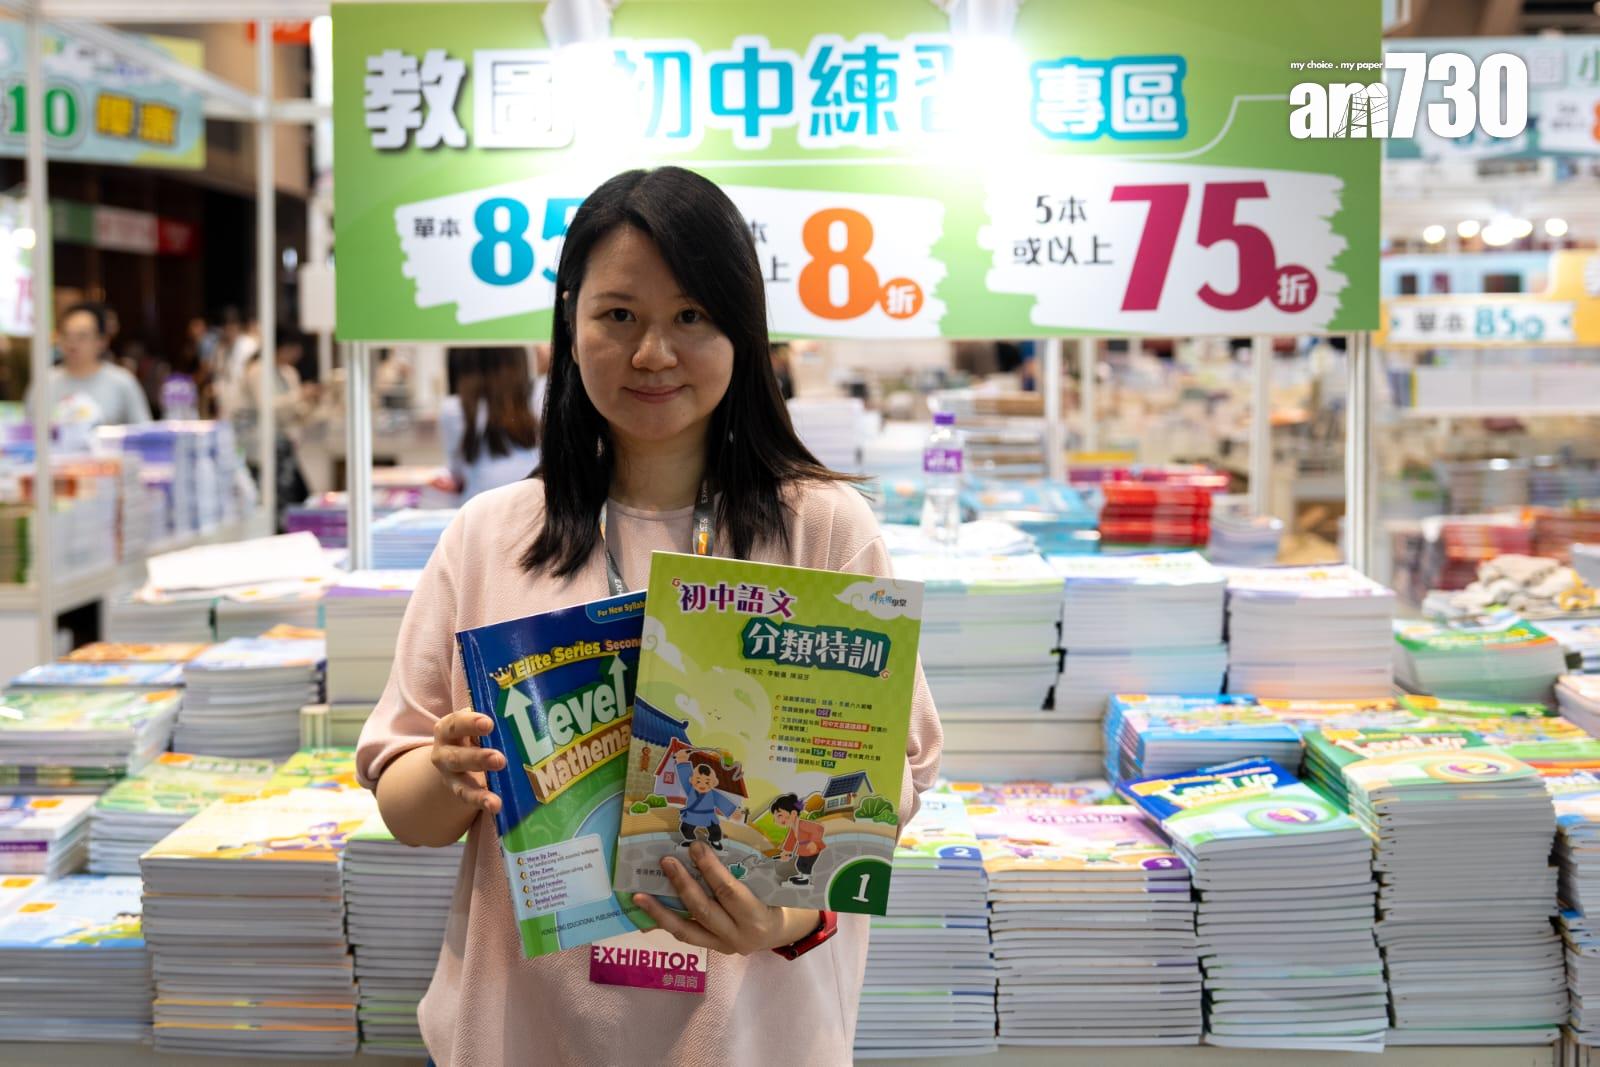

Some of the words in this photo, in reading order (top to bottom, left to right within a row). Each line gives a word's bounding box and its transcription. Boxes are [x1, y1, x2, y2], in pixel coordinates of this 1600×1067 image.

[1036, 195, 1088, 224] 5本
[414, 218, 462, 238] 單本
[1012, 236, 1115, 266] 或以上
[680, 584, 797, 619] 初中語文
[514, 654, 552, 678] Elite
[553, 642, 601, 664] Series
[605, 637, 642, 651] Secon
[748, 622, 885, 672] 分類特訓
[504, 655, 628, 766] Level
[852, 873, 870, 903] 1
[591, 945, 699, 972] EXHIBITOR
